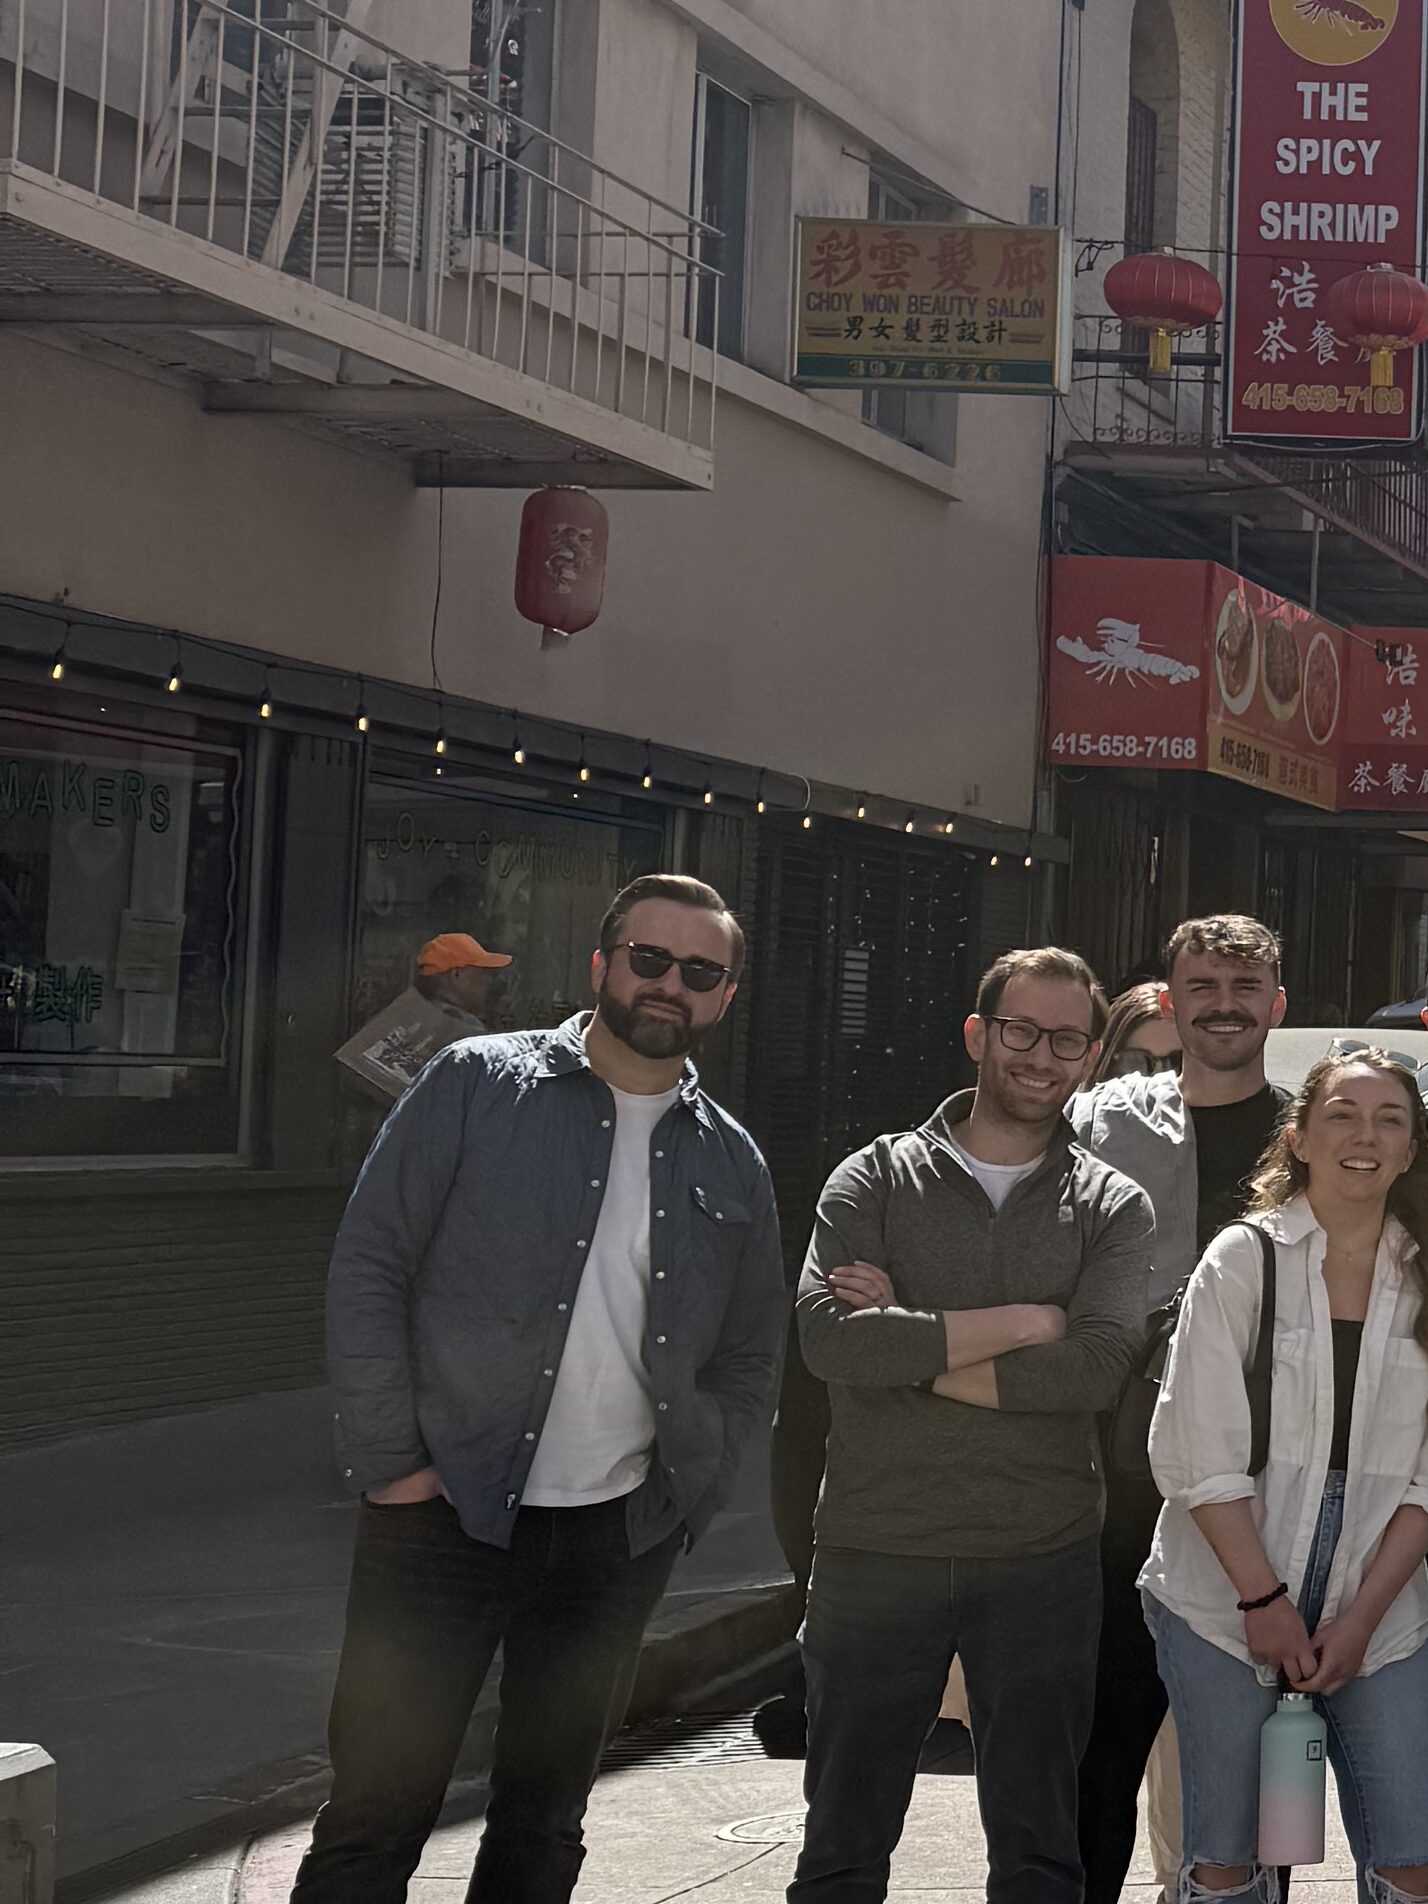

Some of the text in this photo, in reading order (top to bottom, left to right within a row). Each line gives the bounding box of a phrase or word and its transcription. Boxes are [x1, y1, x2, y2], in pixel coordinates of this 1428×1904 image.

[1296, 81, 1369, 122] THE
[1275, 137, 1382, 176] SPICY
[1259, 200, 1399, 244] SHRIMP
[806, 291, 1045, 319] CHOY WON BEAUTY SALON
[1254, 317, 1371, 366] 茶餐
[1242, 382, 1405, 415] 415-658-7168
[1051, 732, 1197, 760] 415-658-7168
